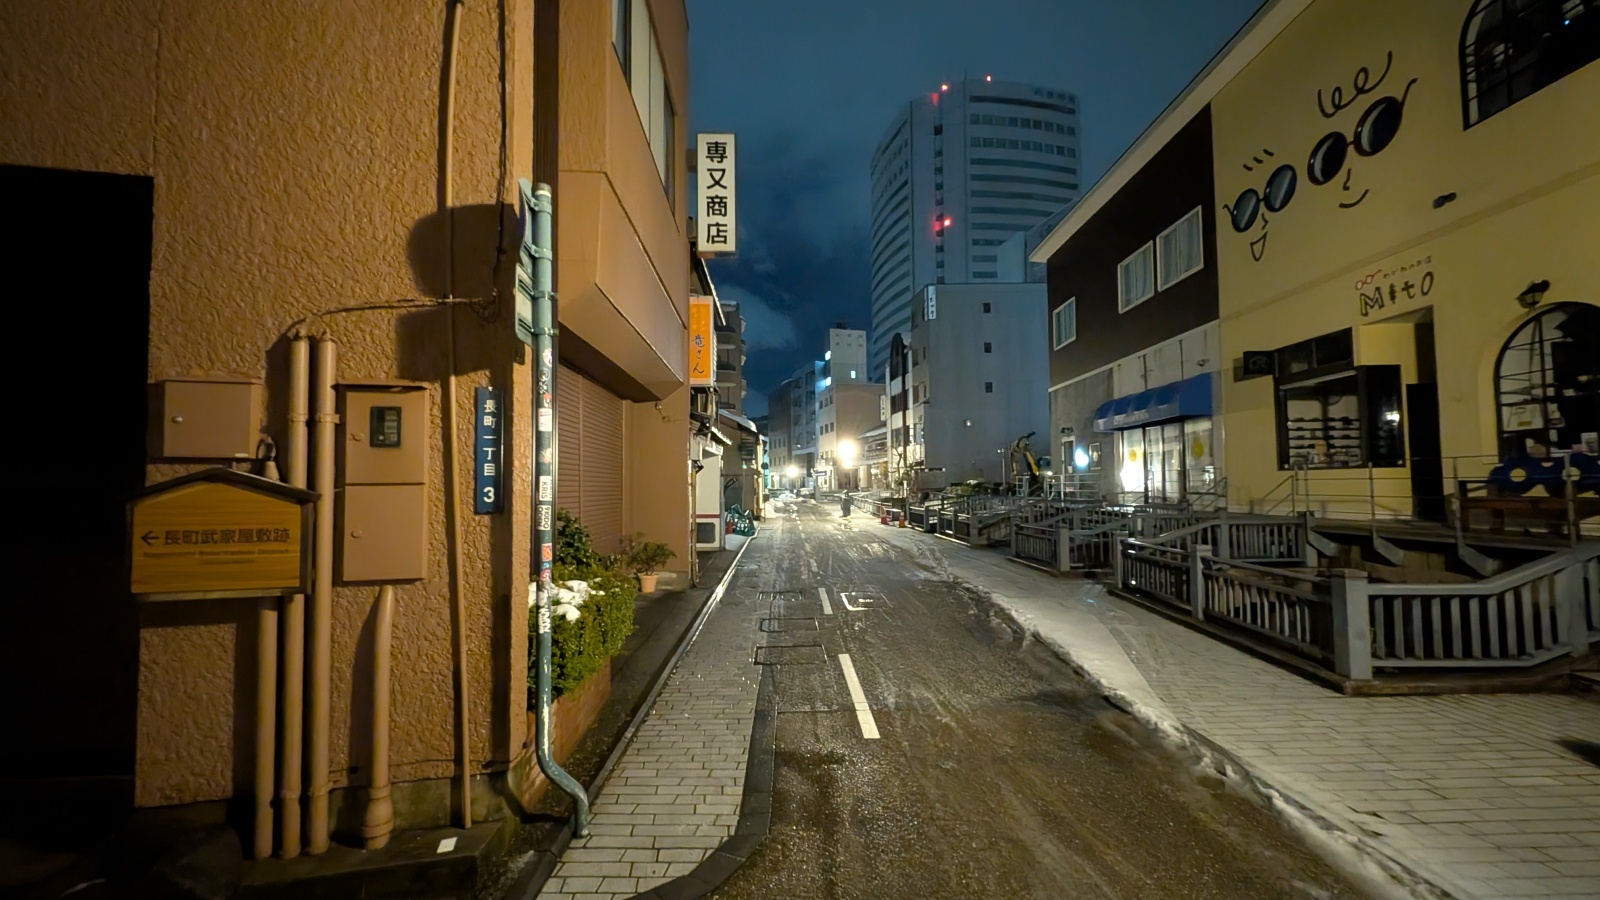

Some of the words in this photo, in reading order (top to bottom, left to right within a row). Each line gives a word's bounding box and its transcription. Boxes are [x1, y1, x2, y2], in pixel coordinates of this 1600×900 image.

[705, 140, 728, 245] 専又商店
[483, 399, 498, 477] 長町一丁目
[483, 487, 495, 503] 3
[164, 527, 290, 546] 長町武家屋敷跡
